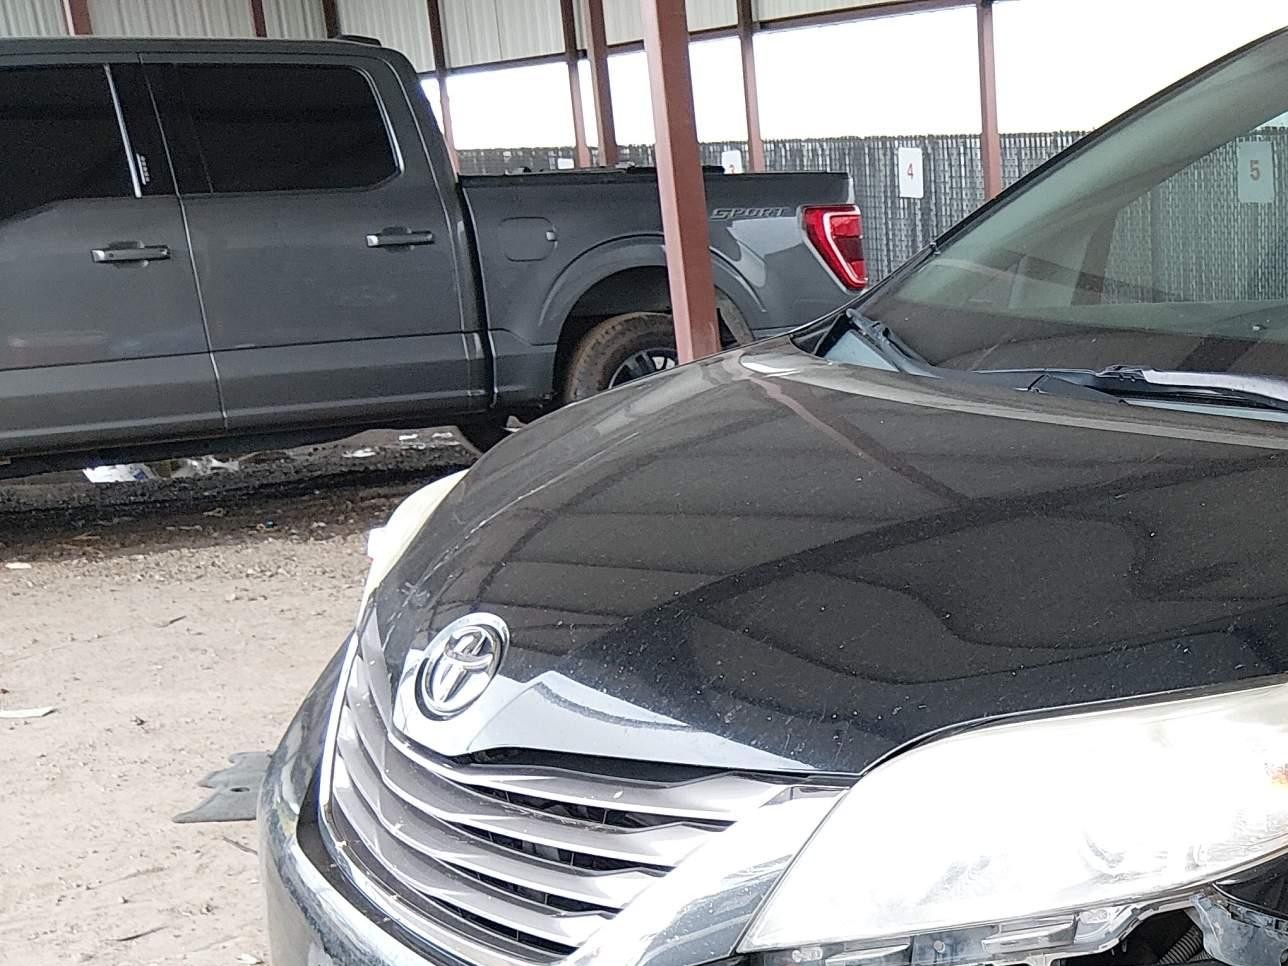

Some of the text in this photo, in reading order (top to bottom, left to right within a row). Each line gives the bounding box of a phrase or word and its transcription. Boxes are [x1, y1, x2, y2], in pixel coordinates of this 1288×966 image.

[907, 162, 914, 180] 4
[1250, 159, 1261, 181] 5
[709, 206, 791, 221] SPORT
